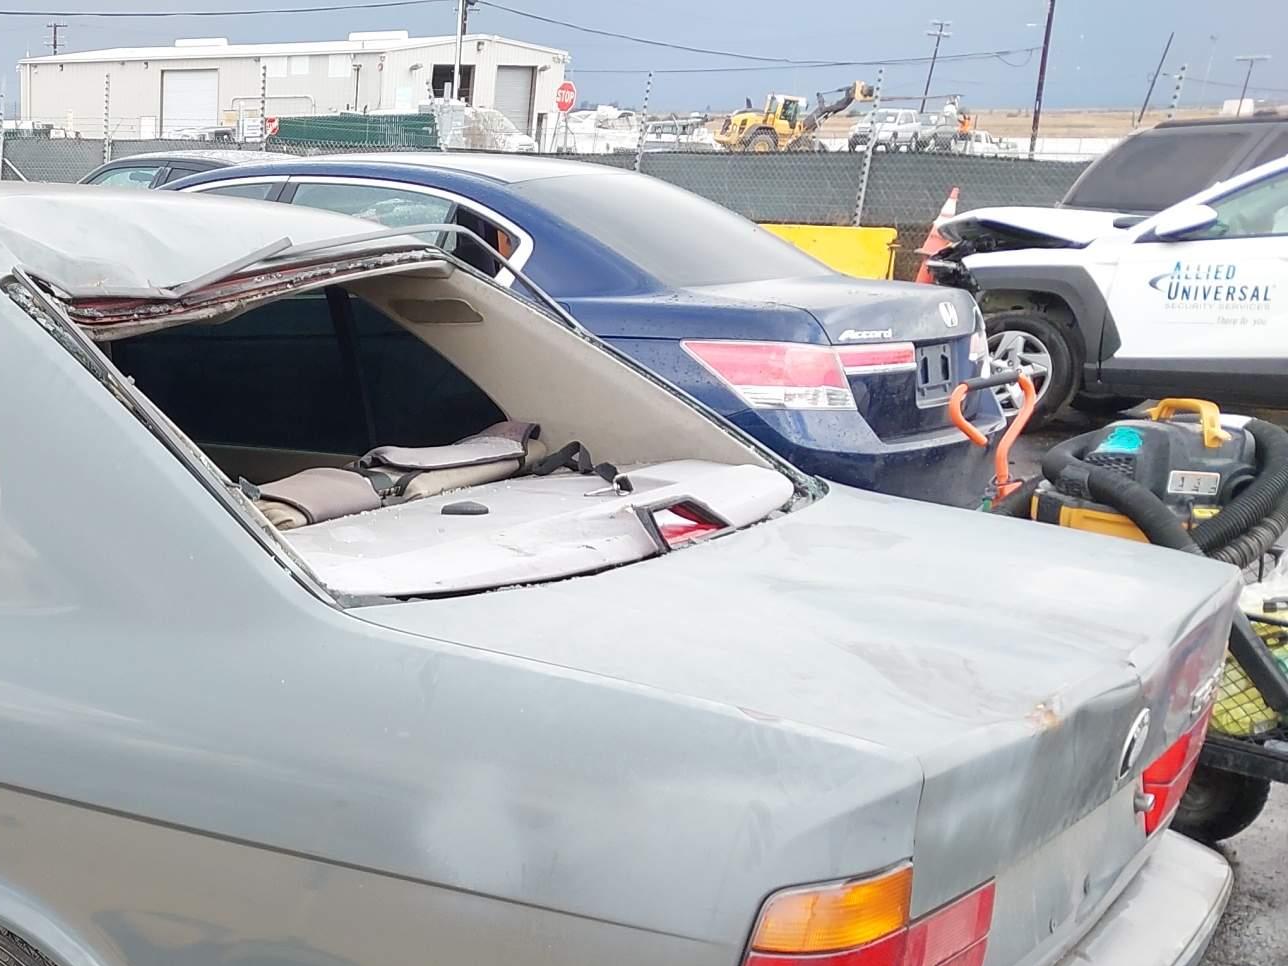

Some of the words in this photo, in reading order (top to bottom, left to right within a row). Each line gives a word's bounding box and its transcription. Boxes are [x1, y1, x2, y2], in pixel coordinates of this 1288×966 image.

[556, 89, 575, 104] STOP
[1170, 261, 1236, 280] ALLIED
[1167, 281, 1272, 301] UNIVERSAL
[1165, 302, 1213, 311] SECURITY
[1218, 302, 1270, 311] SERVICES
[838, 328, 892, 340] Accord
